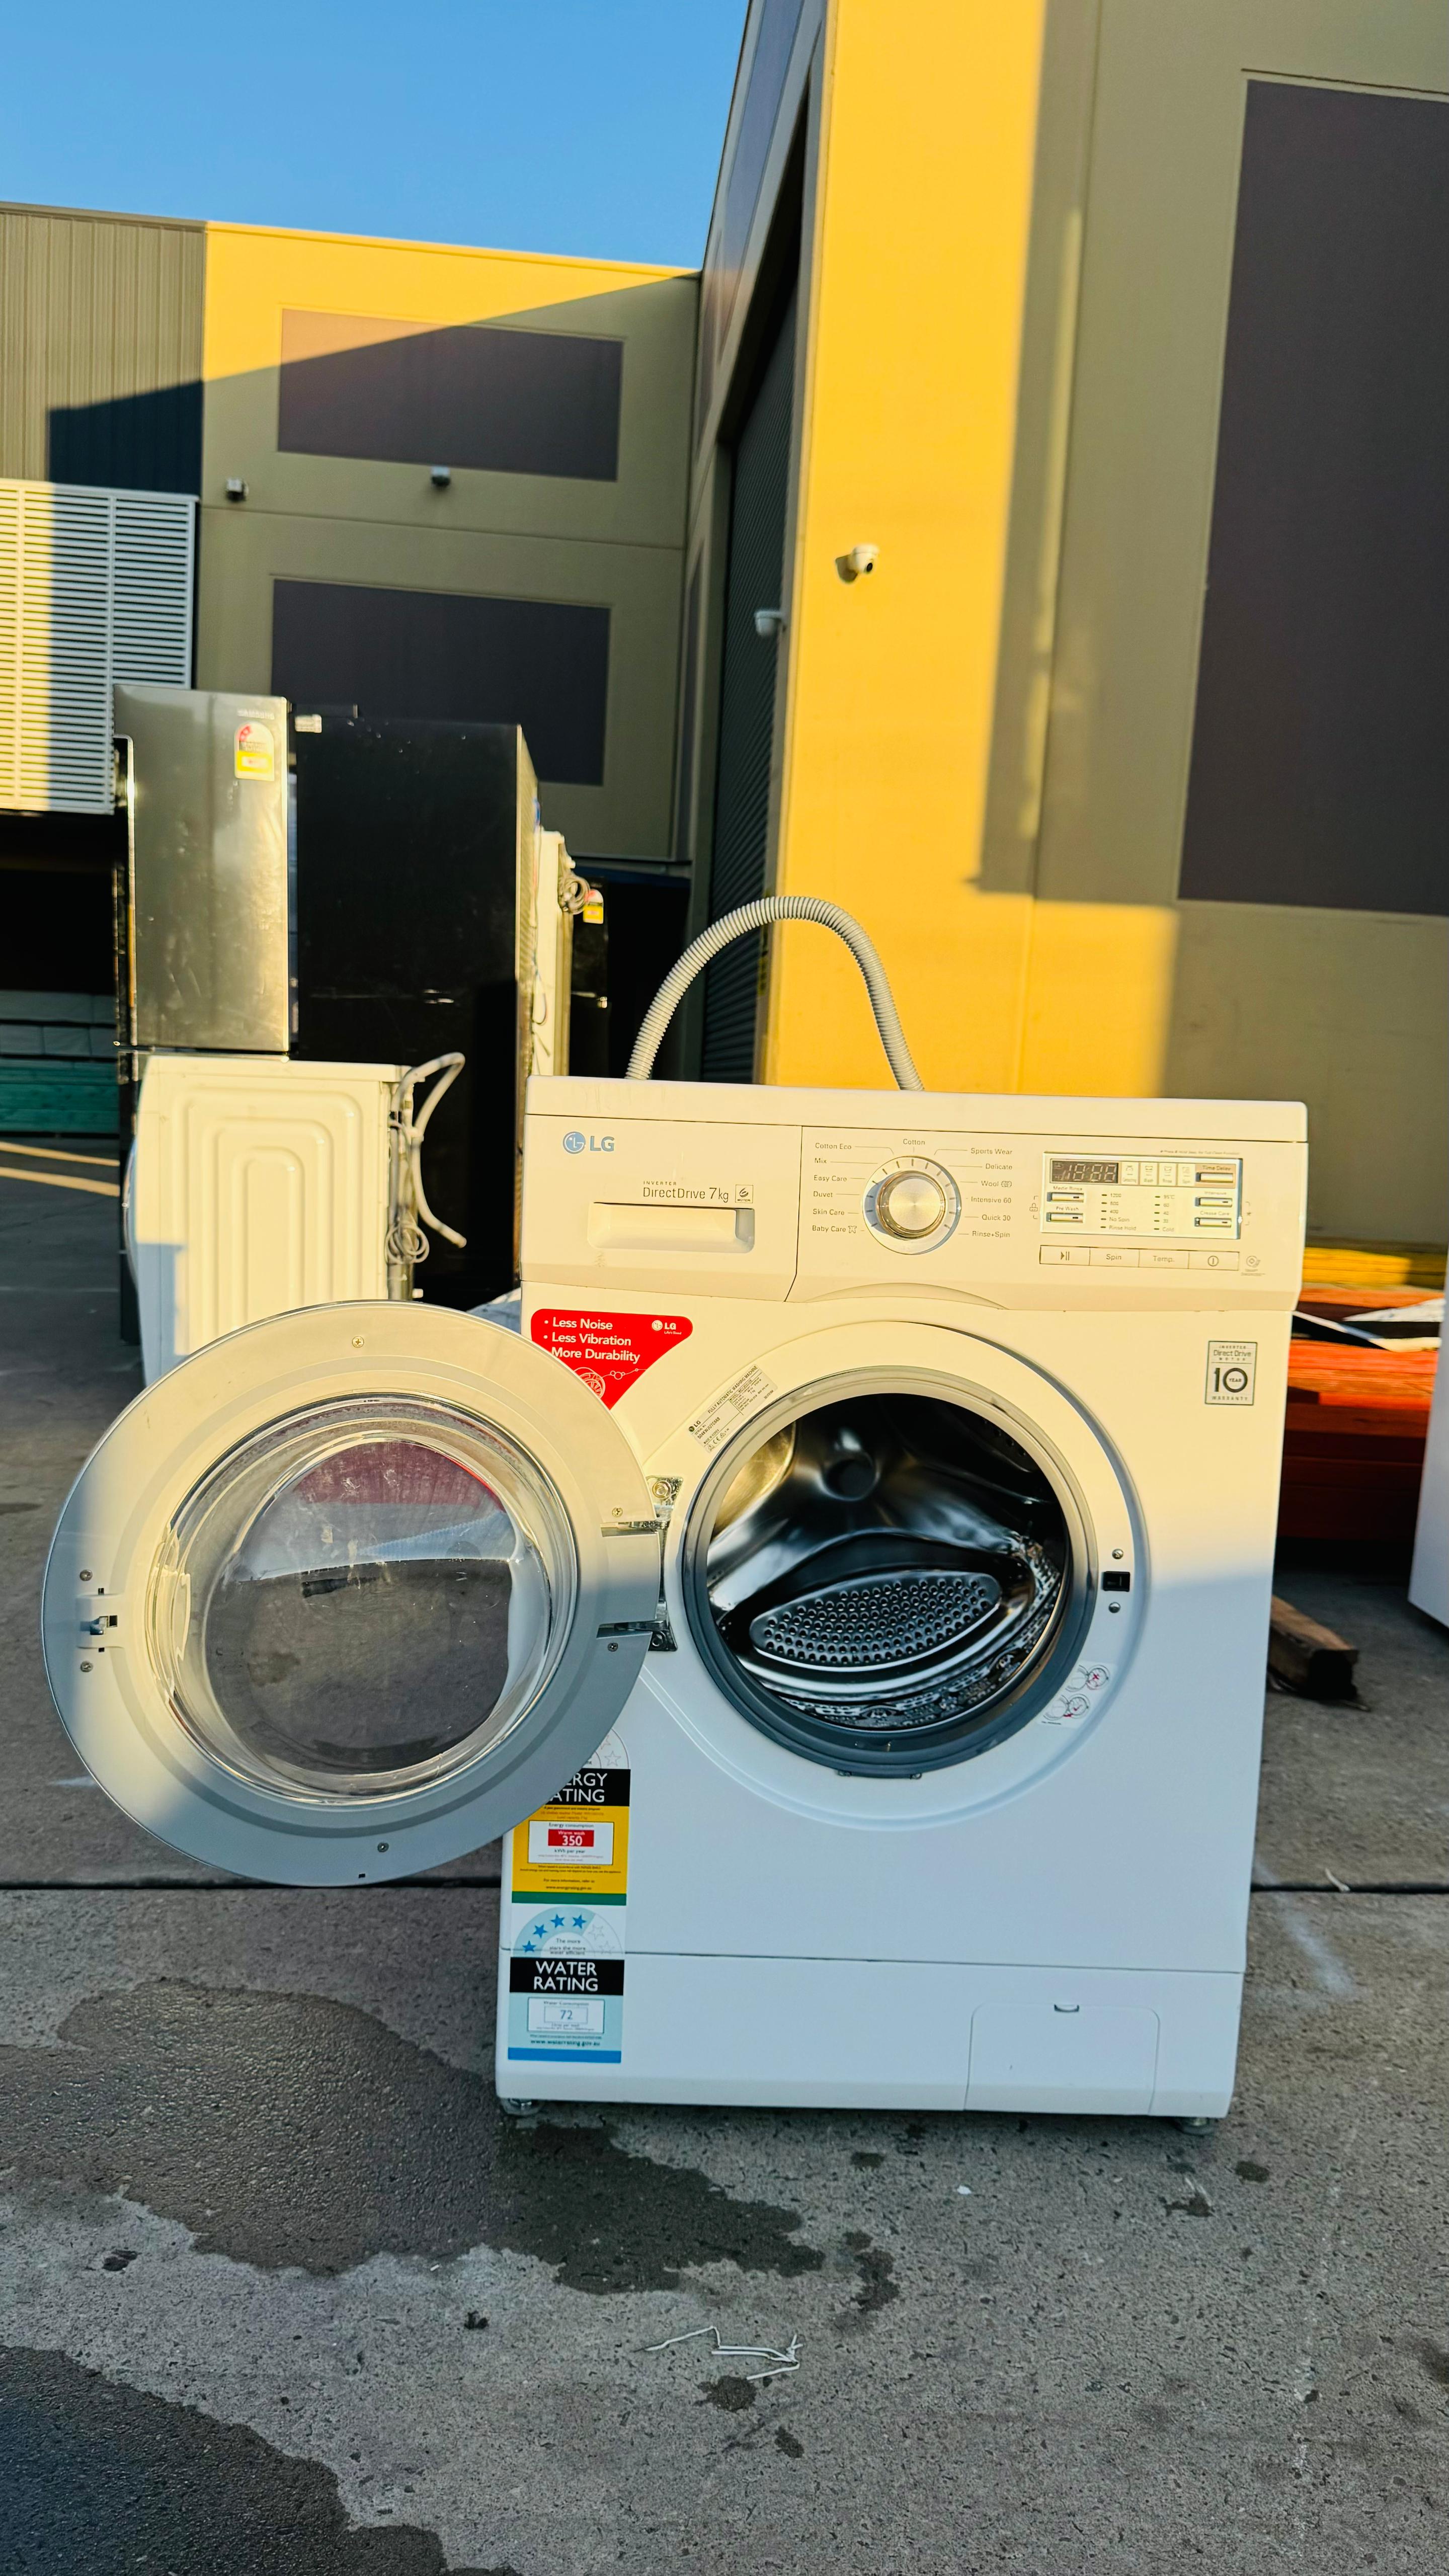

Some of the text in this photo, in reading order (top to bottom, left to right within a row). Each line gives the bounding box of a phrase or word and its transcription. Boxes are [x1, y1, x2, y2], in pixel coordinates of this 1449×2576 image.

[590, 1136, 615, 1152] LG
[709, 1187, 717, 1199] 7
[718, 1188, 729, 1203] kg
[553, 1317, 613, 1330] Less Noise
[552, 1332, 631, 1346] Less Vibration
[551, 1347, 640, 1364] More Durability
[1214, 1368, 1248, 1393] 10
[708, 1404, 717, 1413] FULLY
[717, 1390, 733, 1405] AUTOMATIC
[733, 1377, 746, 1391] WASHING
[744, 1365, 758, 1379] MACHINE
[566, 1773, 607, 1786] RGY
[550, 1789, 604, 1803] ATING
[562, 1835, 583, 1846] 350
[535, 1961, 597, 1976] WATER
[534, 1976, 598, 1991] RATING
[560, 2009, 573, 2019] 72
